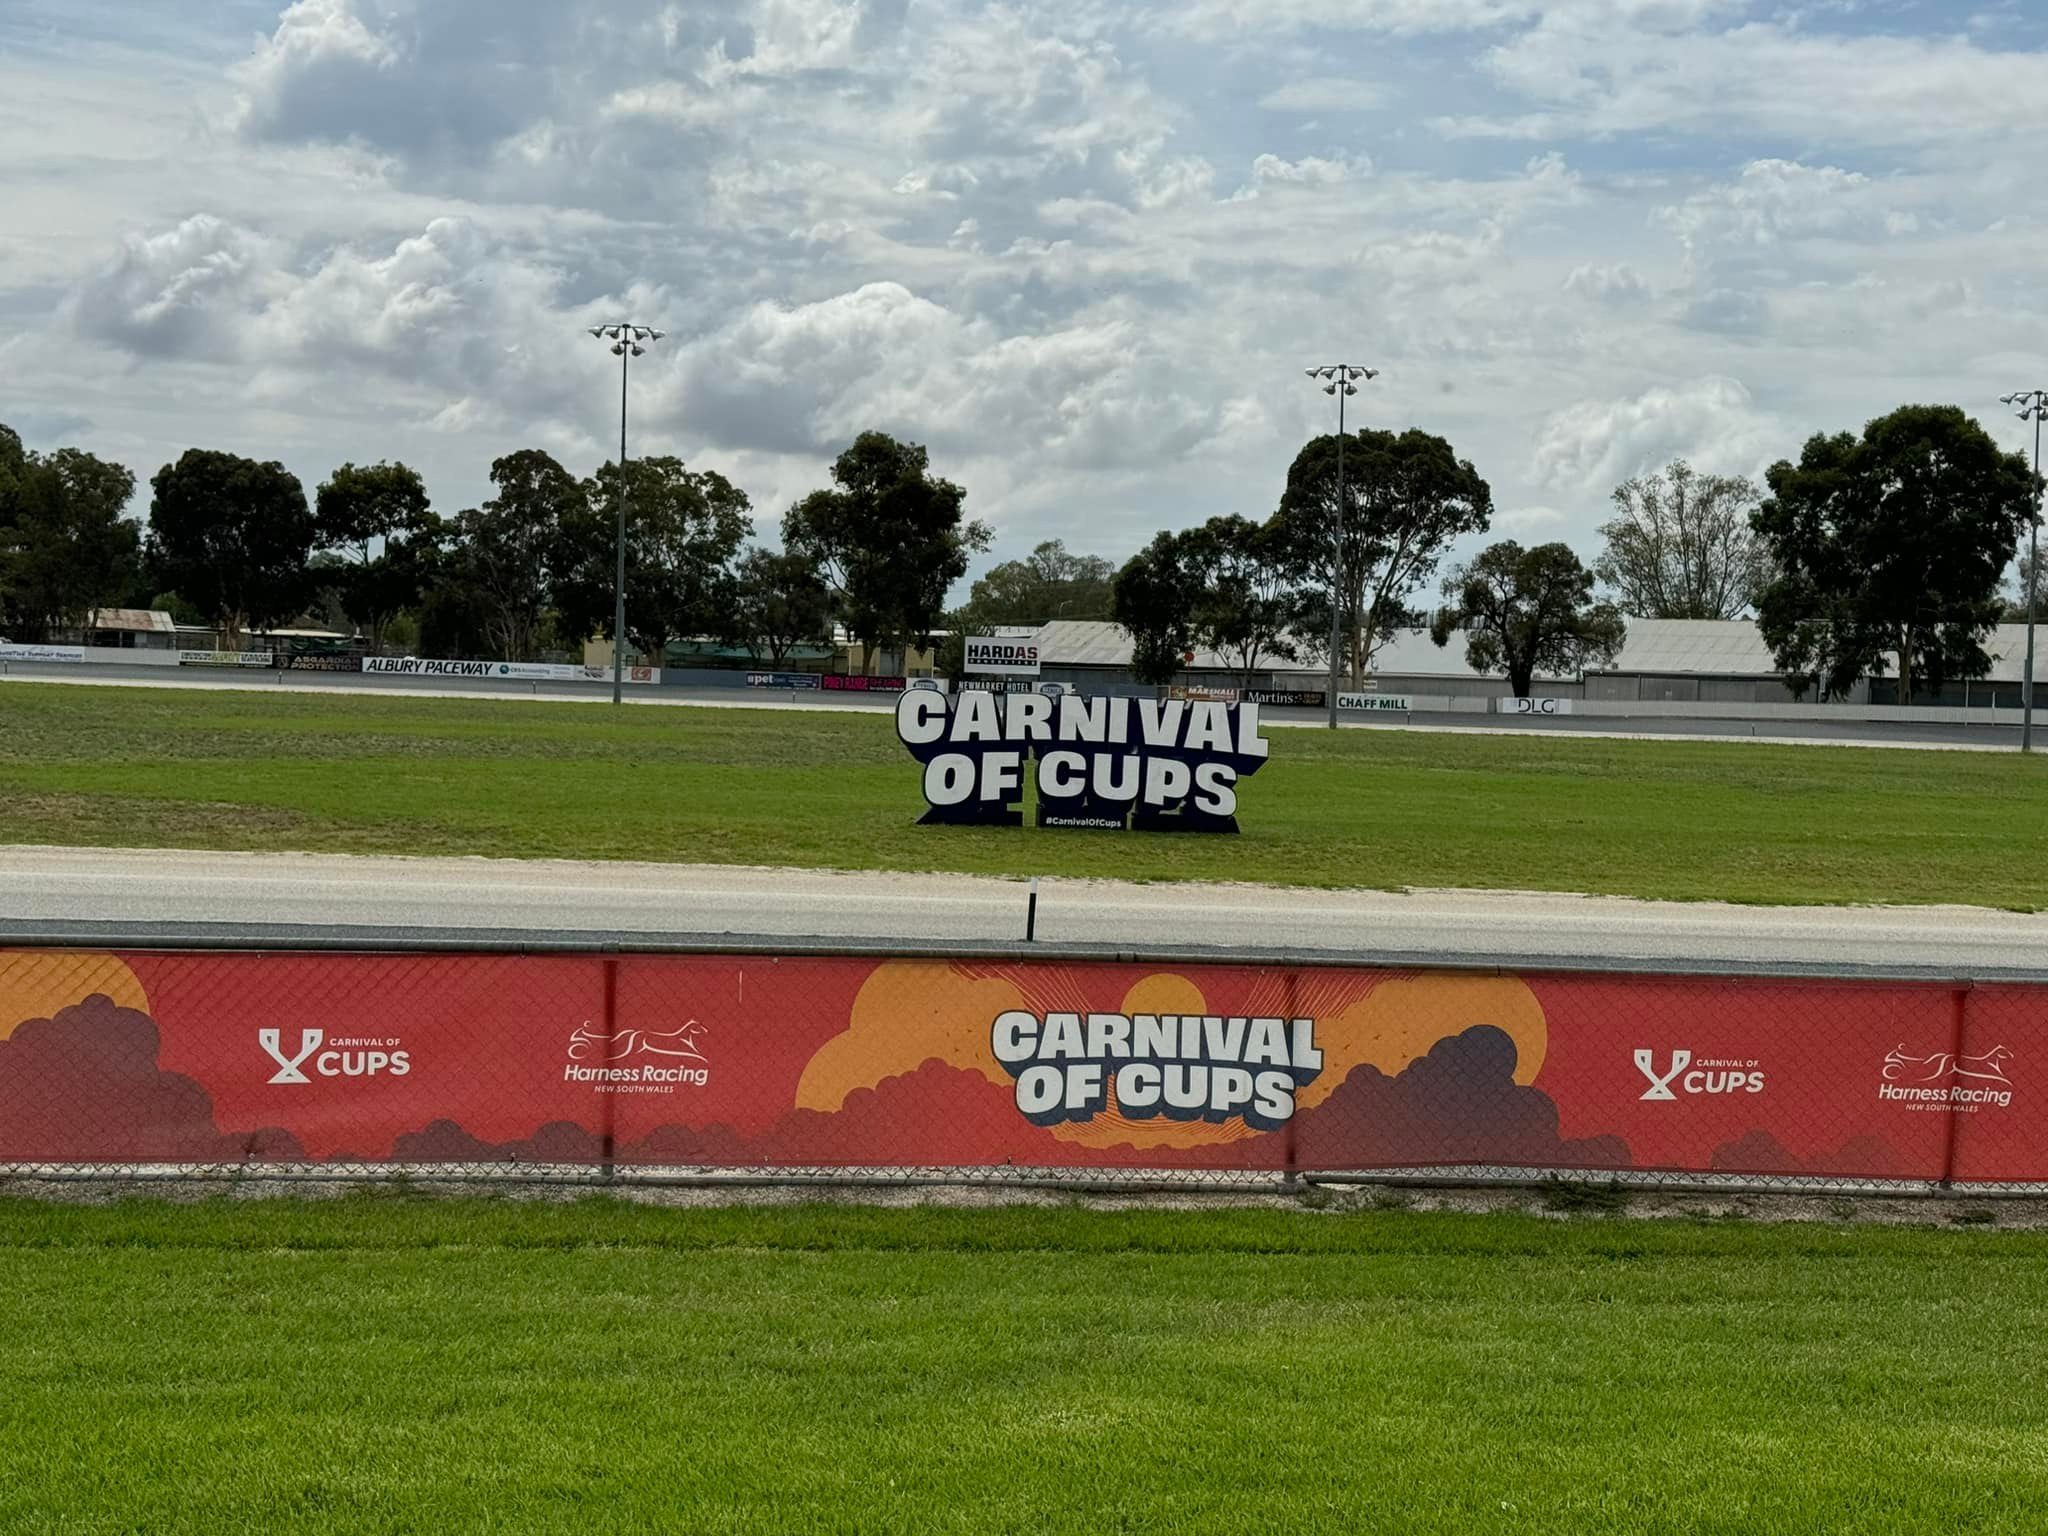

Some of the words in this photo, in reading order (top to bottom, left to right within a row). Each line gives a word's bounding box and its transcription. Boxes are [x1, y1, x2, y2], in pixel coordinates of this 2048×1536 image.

[967, 644, 1038, 659] HARDAS
[290, 662, 360, 671] PROTECTION
[366, 659, 423, 673] ALBURY
[424, 660, 493, 676] PACEWAY
[959, 680, 1005, 692] NEWMARKET
[1006, 681, 1029, 692] HOTEL
[1188, 687, 1235, 696] MARSHALL
[1338, 696, 1377, 709] CHAFF
[1379, 699, 1408, 710] MILL
[1518, 698, 1554, 714] DLG
[898, 689, 1269, 758] CARNIVAL
[924, 751, 1020, 806] OF
[1038, 750, 1238, 816] CUPS
[1045, 816, 1122, 829] #CarnivalOfCups
[329, 1037, 383, 1047] CARNIVAL
[386, 1037, 401, 1047] OF
[992, 1010, 1323, 1070] CARNIVAL
[316, 1050, 411, 1076] CUPS
[1696, 1059, 1743, 1067] CARNIVAL
[1746, 1060, 1759, 1068] OF
[564, 1064, 639, 1082] Harness
[642, 1064, 709, 1087] Racing
[1683, 1070, 1765, 1094] CUPS
[594, 1085, 614, 1093] NEW
[616, 1085, 645, 1093] SOUTH
[646, 1085, 674, 1094] WALES
[1016, 1063, 1102, 1114] OF
[1115, 1062, 1295, 1120] CUPS
[1878, 1083, 1948, 1101] Harness
[1950, 1086, 2012, 1107] Racing
[1926, 1104, 1951, 1112] SOUTH
[1952, 1105, 1979, 1113] WALES
